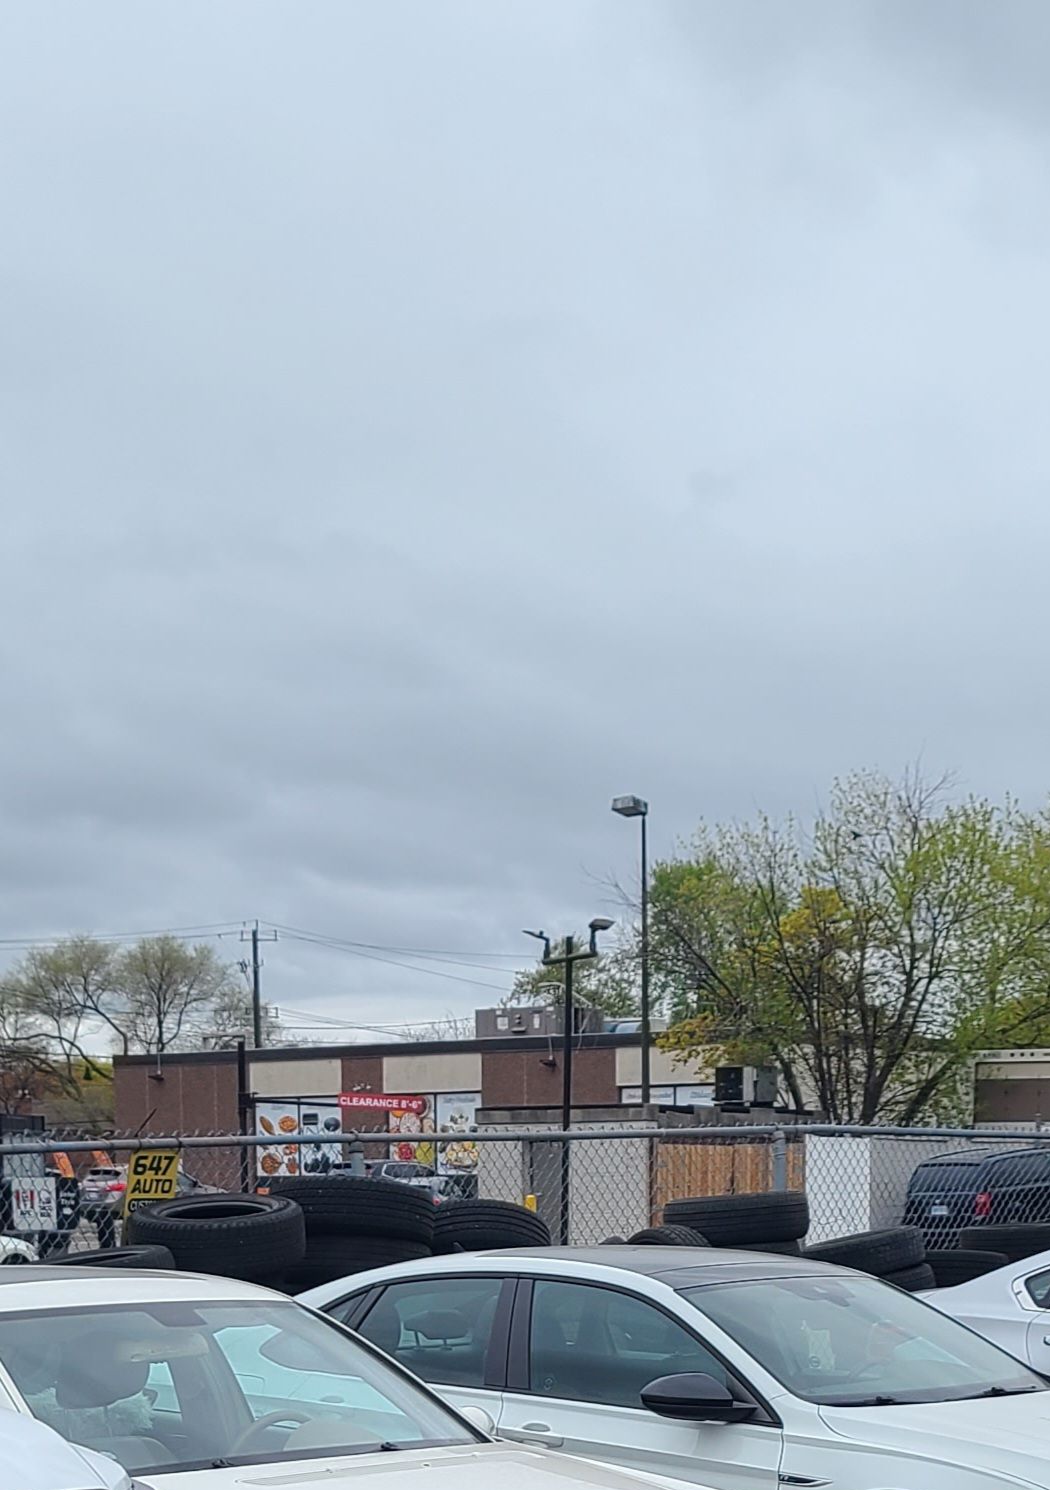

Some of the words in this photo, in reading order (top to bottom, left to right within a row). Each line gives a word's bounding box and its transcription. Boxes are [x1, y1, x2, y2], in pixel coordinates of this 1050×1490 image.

[340, 1096, 399, 1108] CLEARANCE
[133, 1155, 176, 1176] 647
[131, 1179, 173, 1194] AUTO
